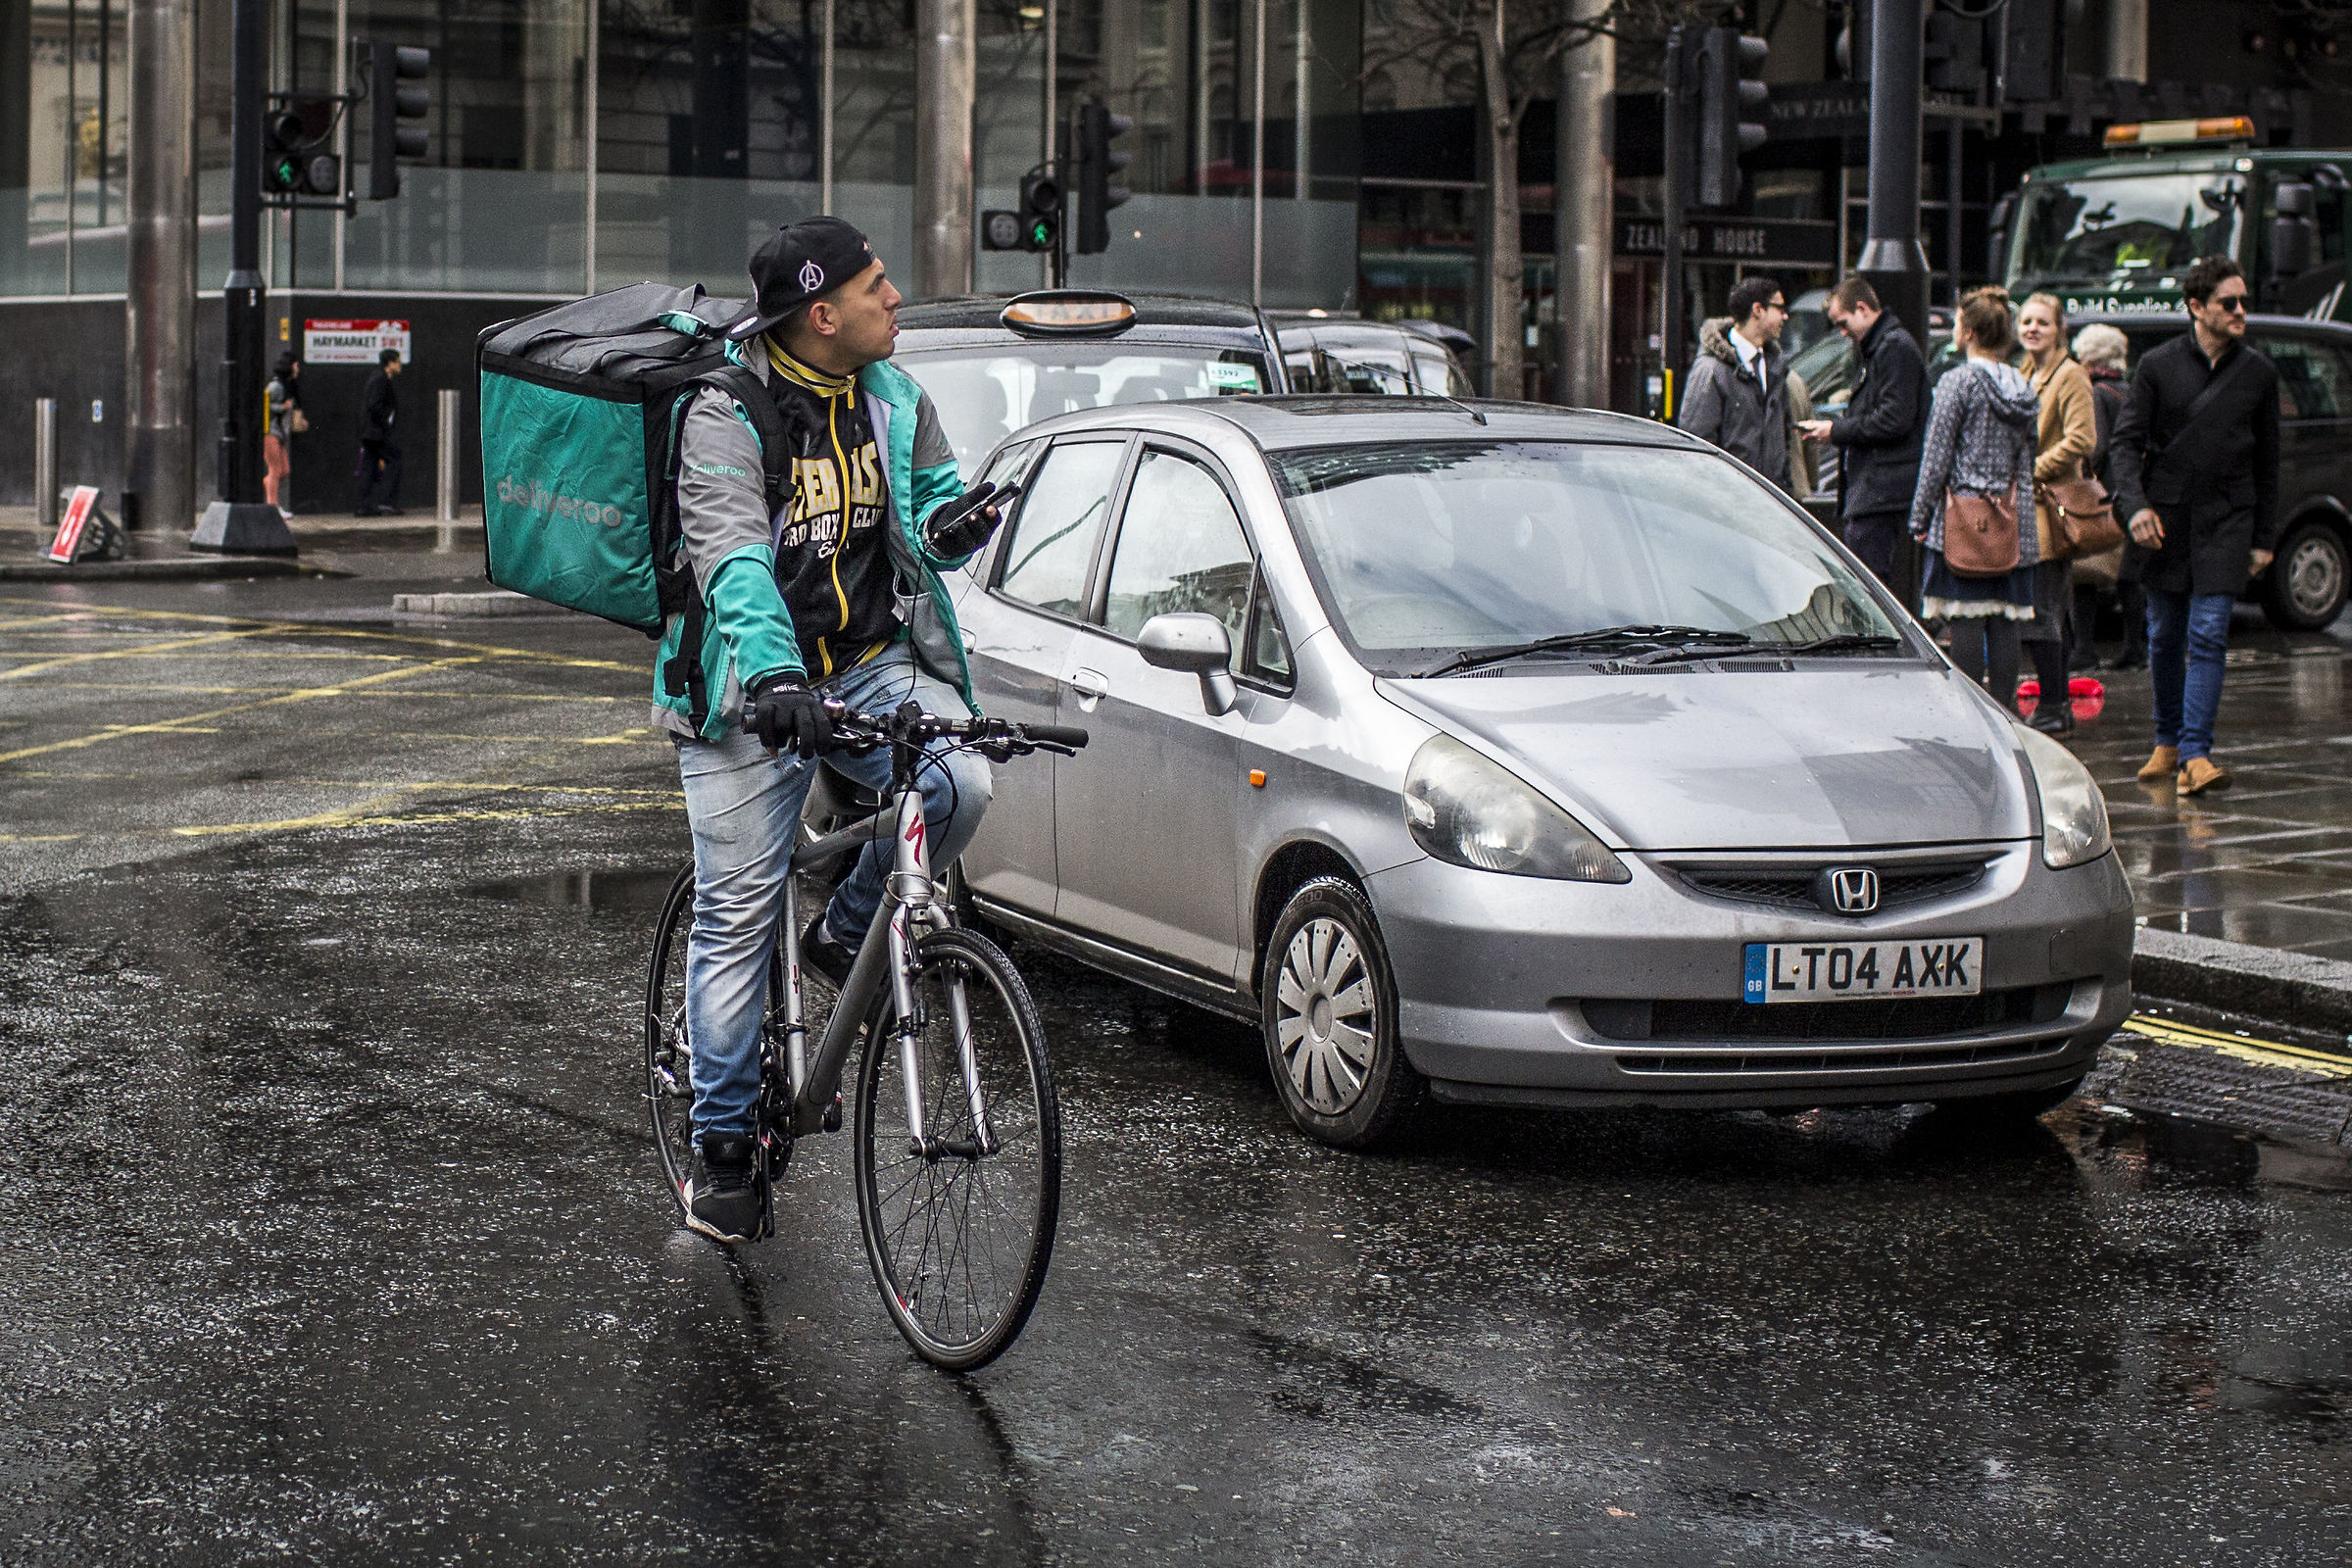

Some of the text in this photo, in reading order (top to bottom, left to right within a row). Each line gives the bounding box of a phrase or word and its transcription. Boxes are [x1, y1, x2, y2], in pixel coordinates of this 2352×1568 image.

[313, 336, 376, 348] HAYMARKET
[497, 474, 621, 527] deliveroo
[1771, 943, 1970, 991] LT04 AXK
[1747, 979, 1763, 993] GB
